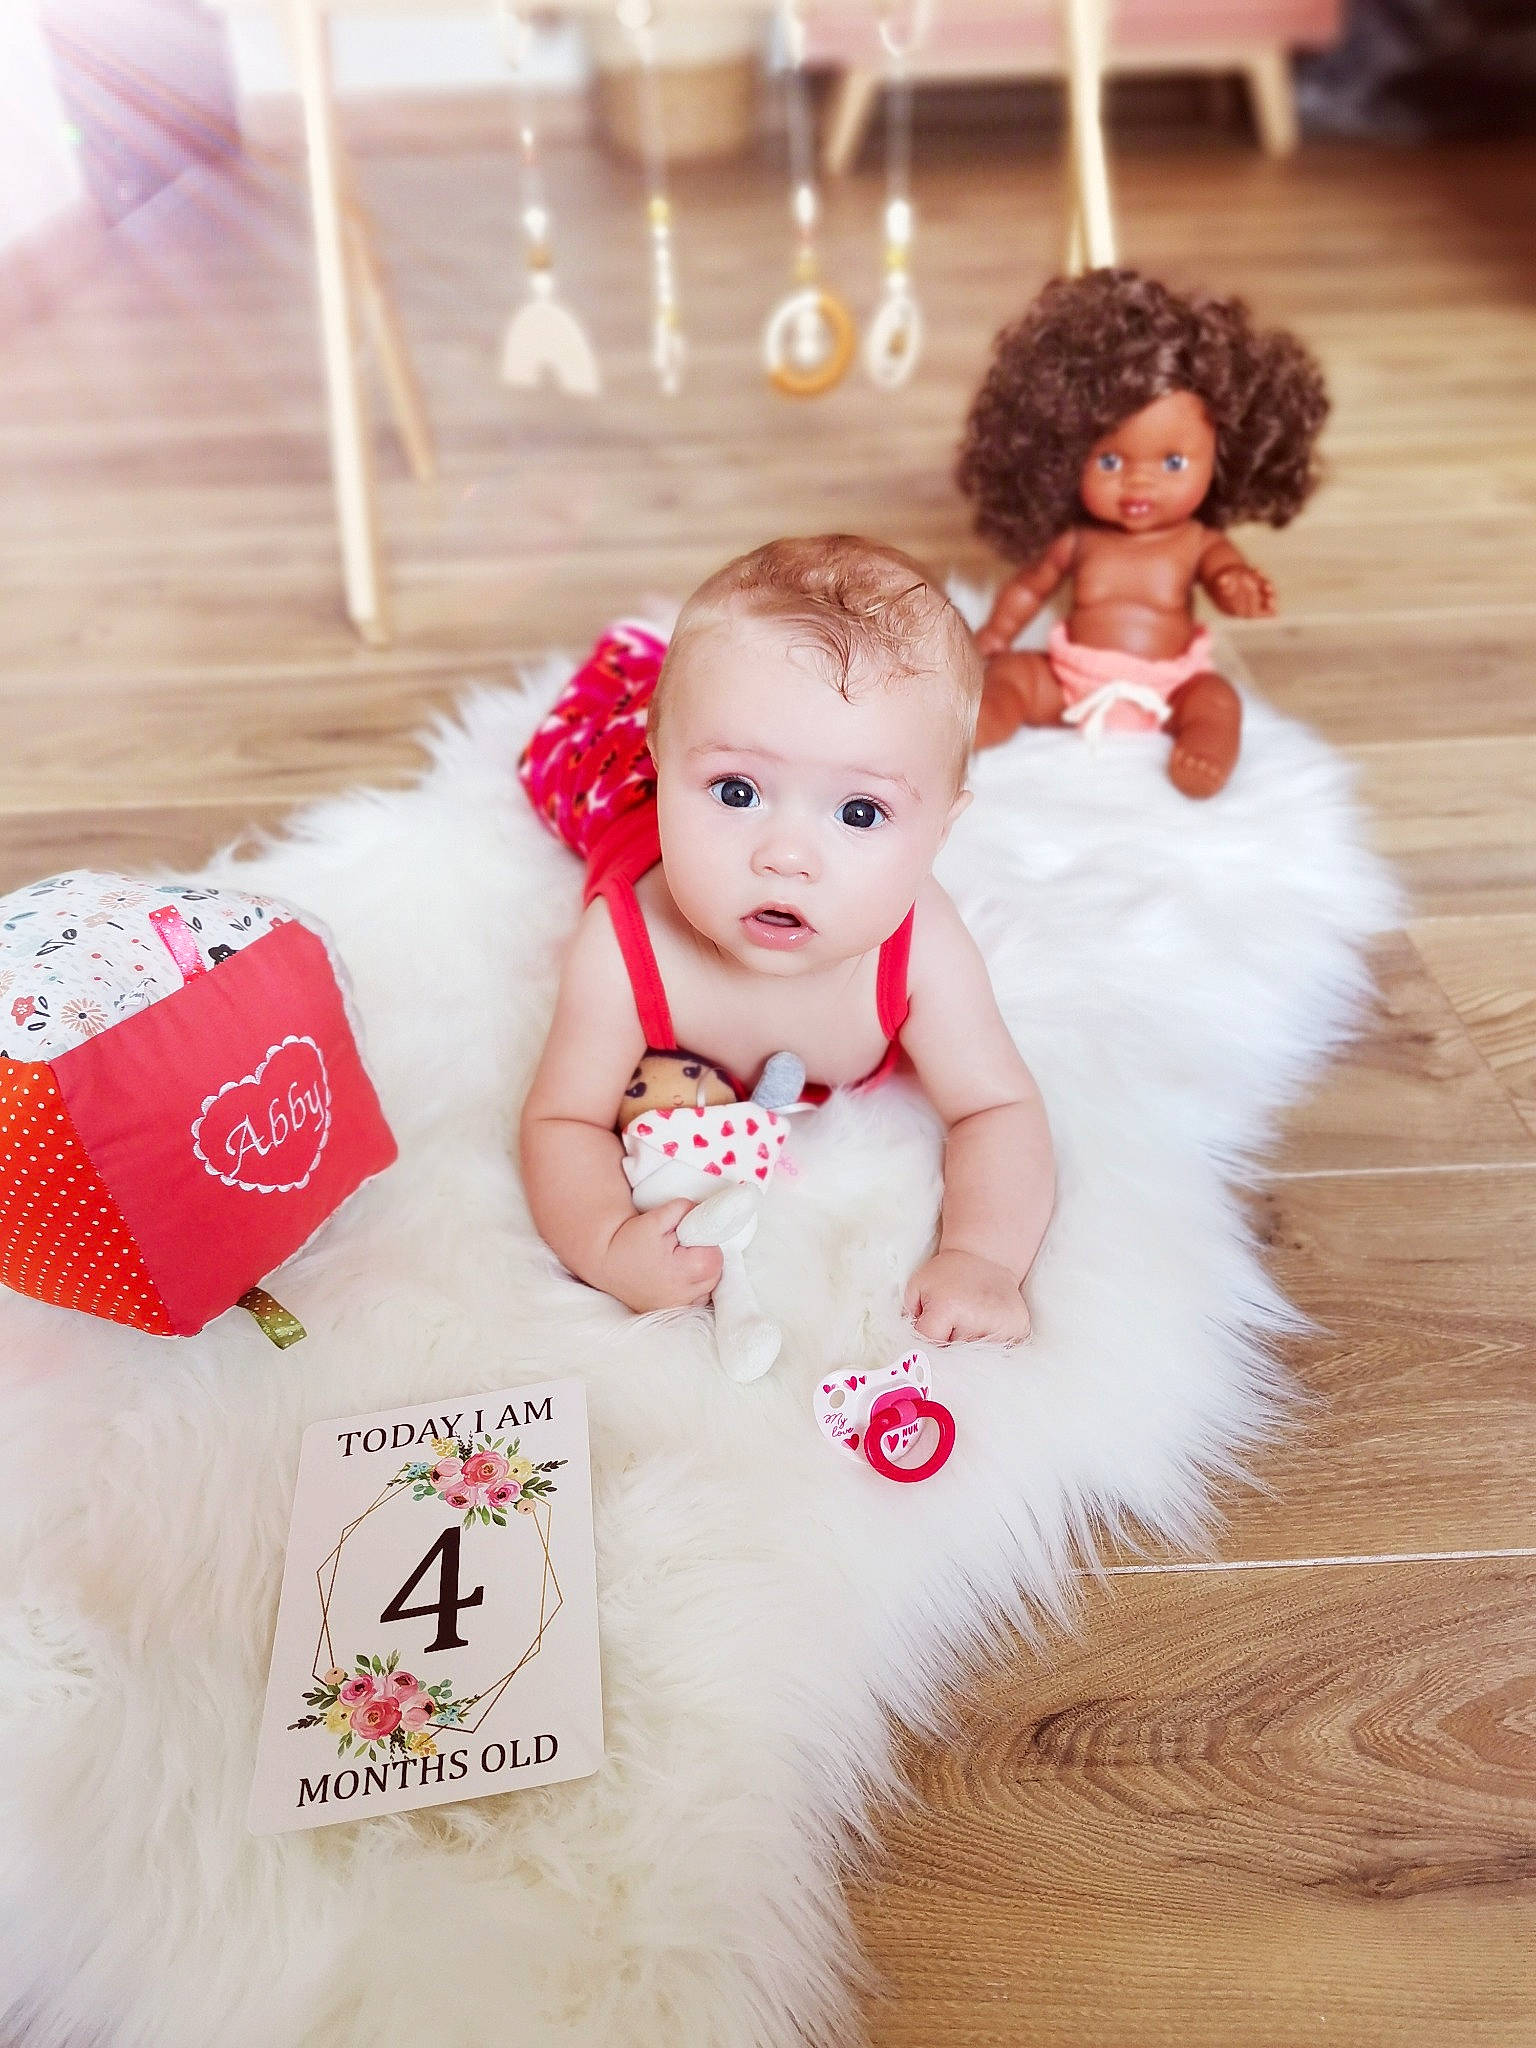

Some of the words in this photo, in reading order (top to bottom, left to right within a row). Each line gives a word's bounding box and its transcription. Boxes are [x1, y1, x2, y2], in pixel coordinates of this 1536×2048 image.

[226, 1081, 324, 1178] Abby
[337, 1413, 464, 1457] TODAY
[473, 1409, 485, 1433] I
[495, 1397, 555, 1430] AM
[823, 1412, 848, 1429] My
[902, 1424, 918, 1437] NUK
[380, 1526, 485, 1654] 4
[296, 1749, 469, 1808] MONTHS
[480, 1733, 559, 1773] OLD
